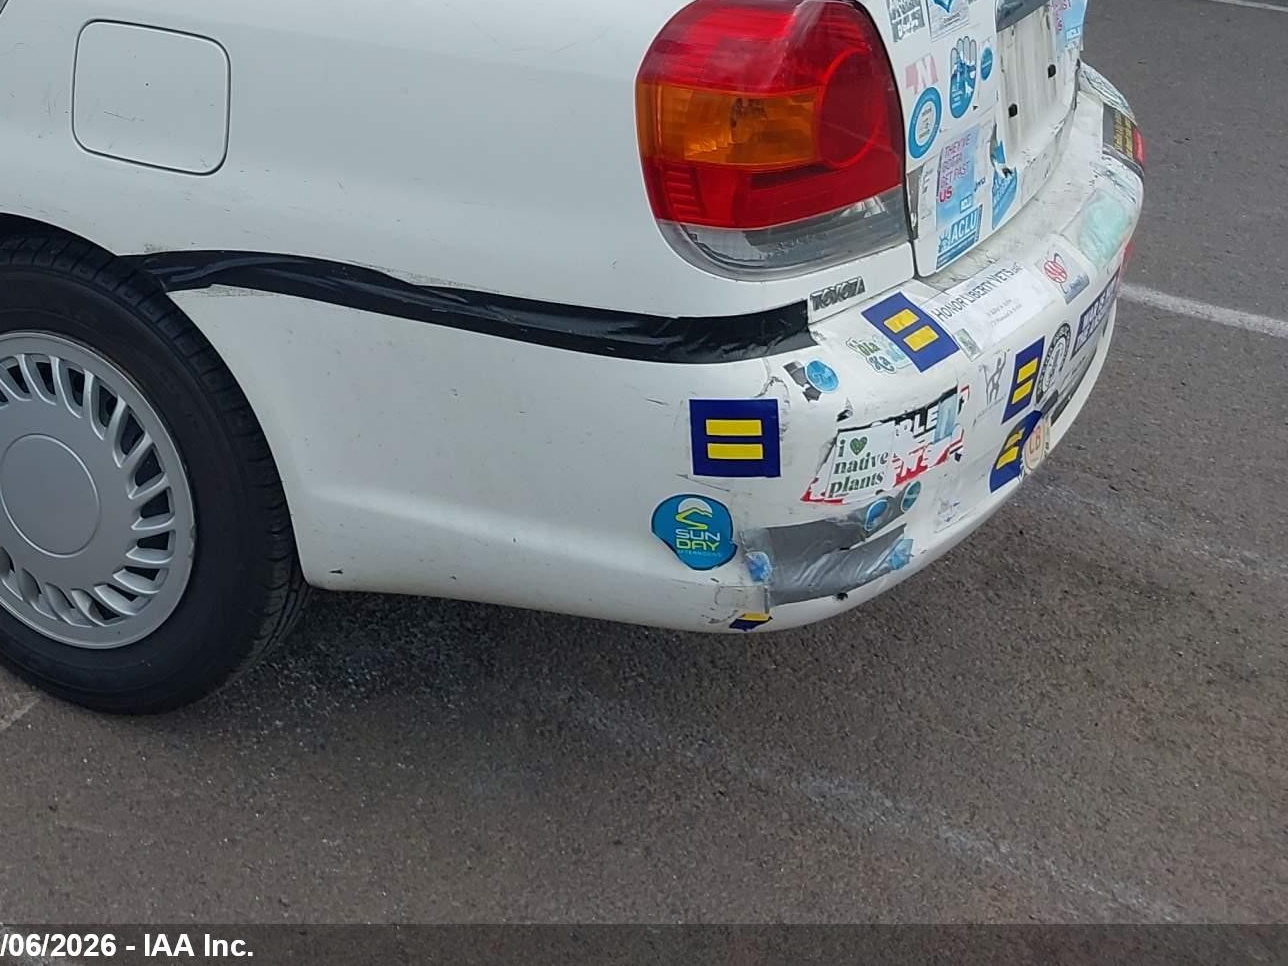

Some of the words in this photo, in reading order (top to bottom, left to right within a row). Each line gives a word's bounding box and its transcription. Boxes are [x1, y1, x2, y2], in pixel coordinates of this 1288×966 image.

[939, 185, 953, 203] US
[951, 210, 978, 243] ACLU
[931, 296, 967, 323] HONOR
[963, 275, 998, 304] LIBERTY
[837, 439, 846, 458] i
[833, 451, 889, 476] native
[829, 471, 885, 498] plants
[675, 529, 721, 541] SUN
[676, 538, 721, 551] DAY
